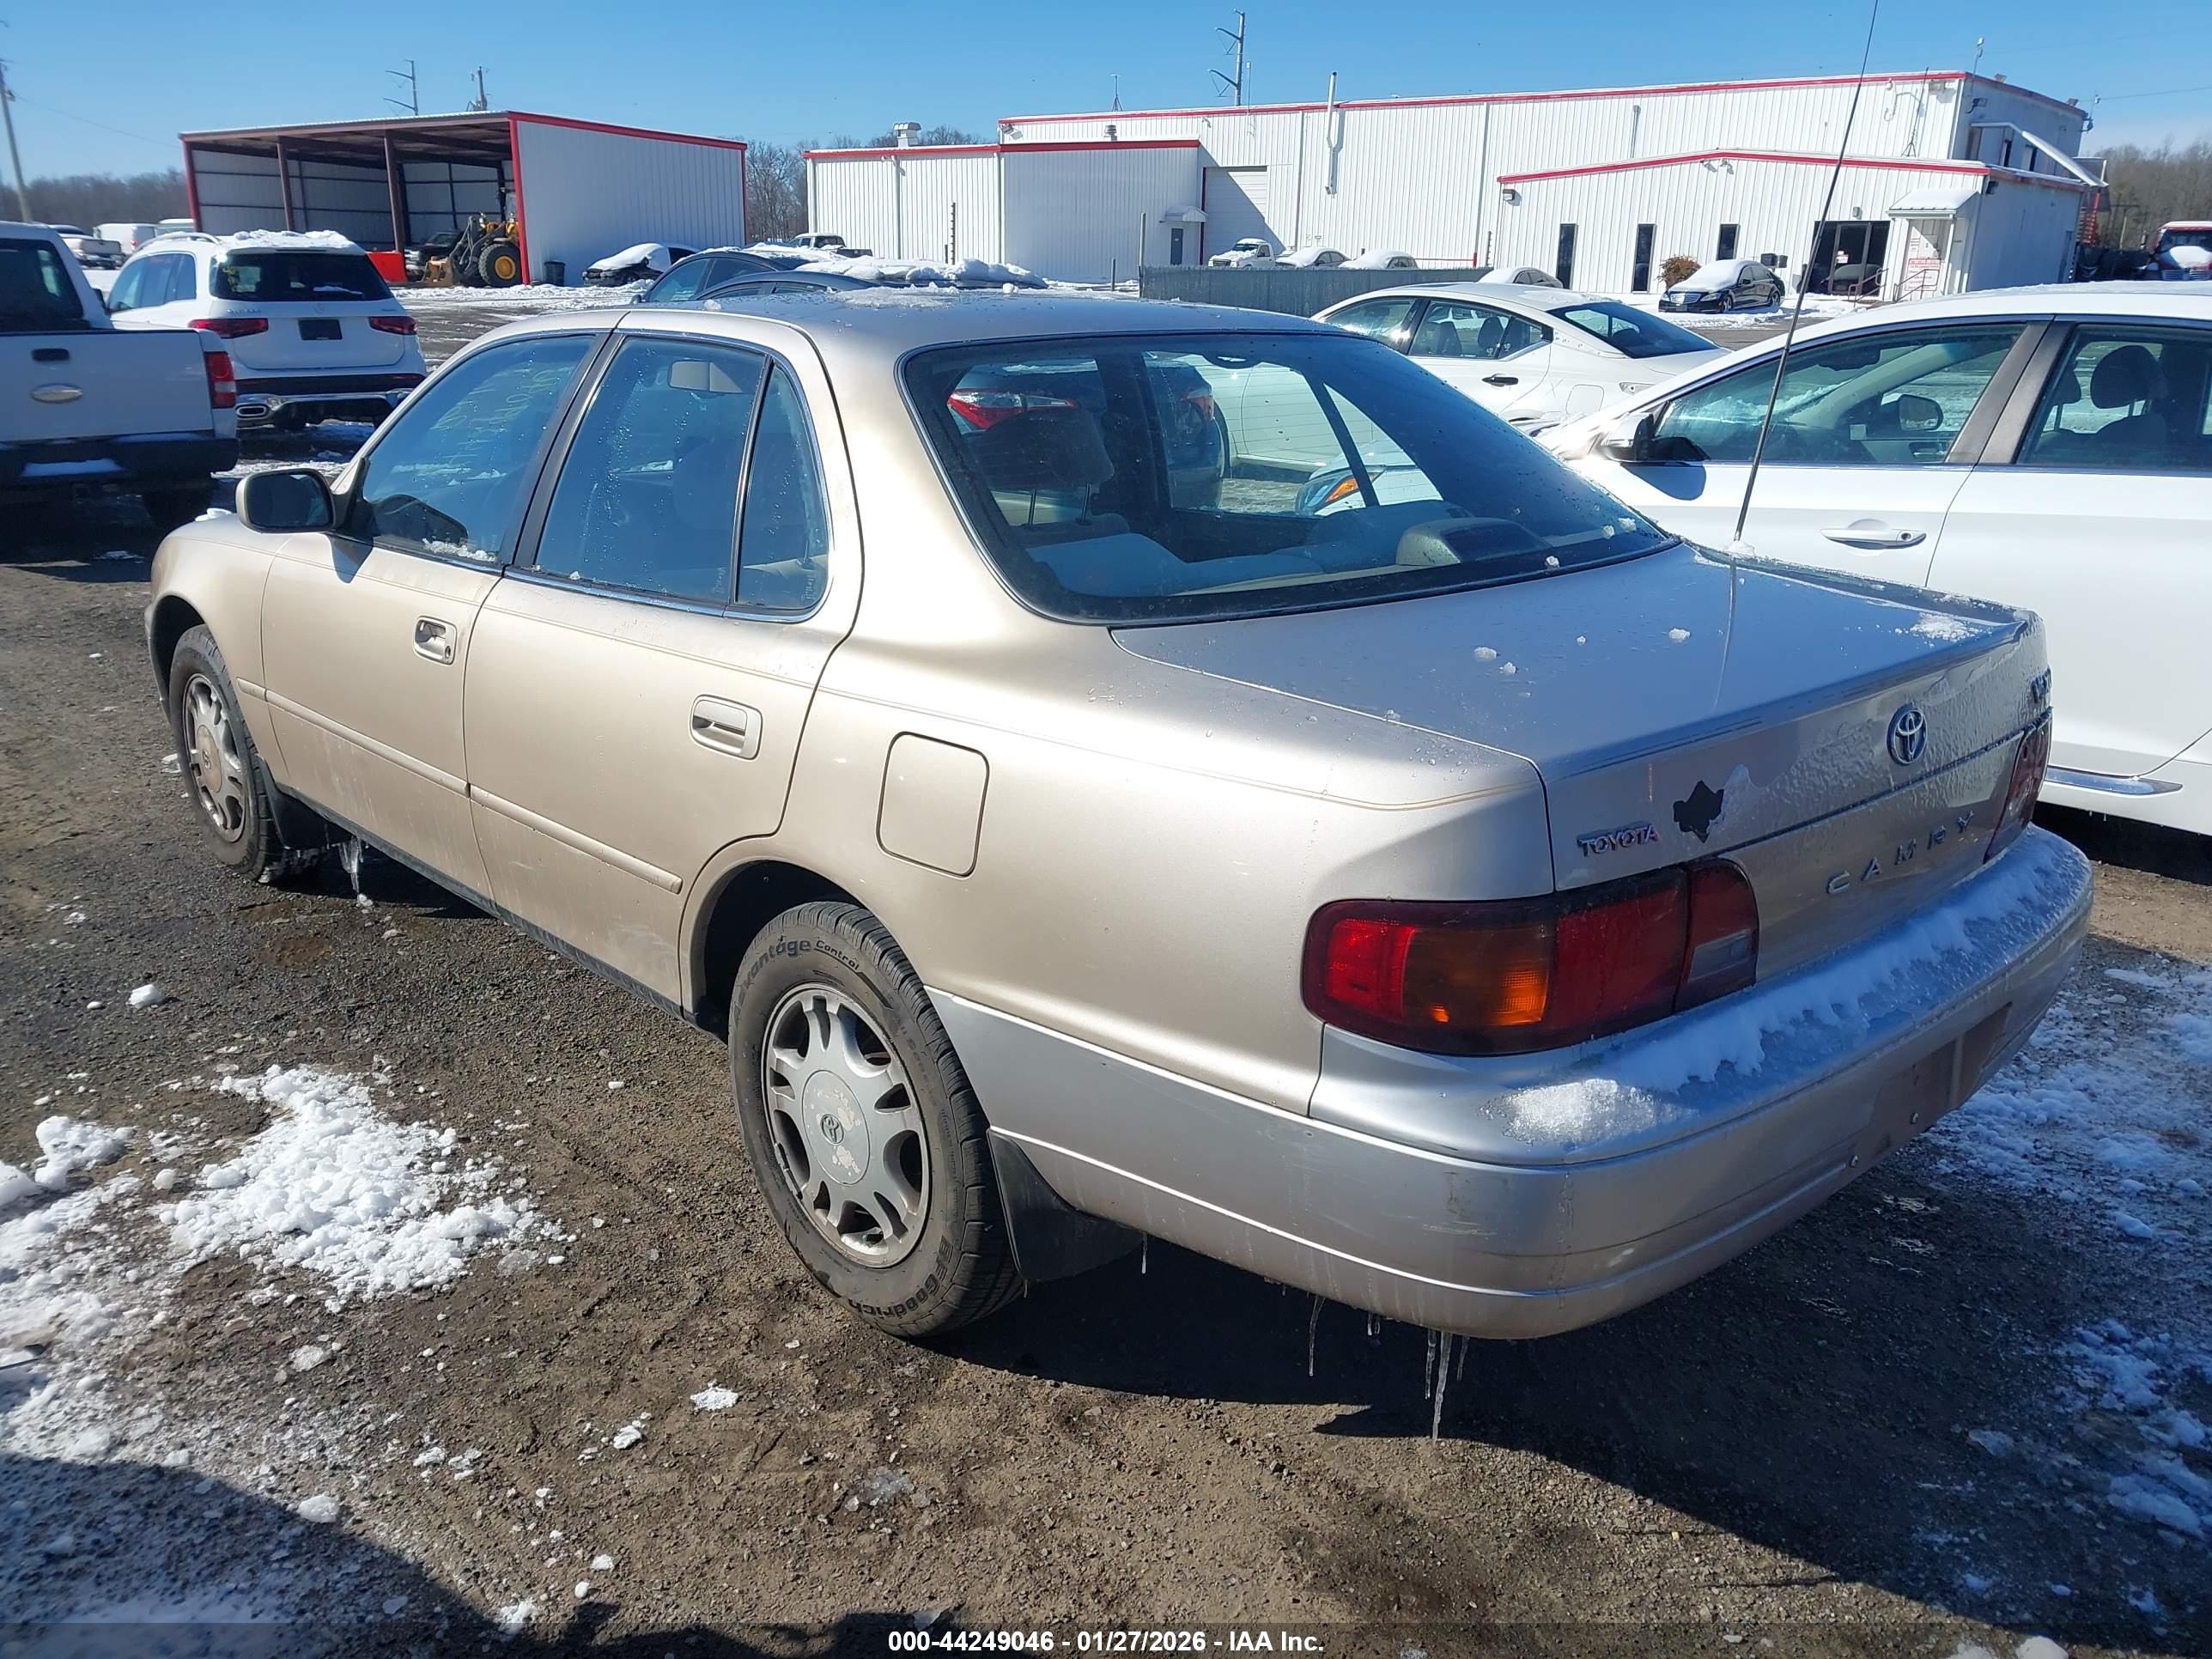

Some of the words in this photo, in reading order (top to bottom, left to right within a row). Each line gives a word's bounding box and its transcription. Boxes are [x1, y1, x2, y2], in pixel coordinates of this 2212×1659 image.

[1578, 823, 1659, 857] TOYOTA
[1826, 810, 1974, 895] CAMRY
[816, 939, 860, 971] Control
[848, 1235, 953, 1320] BFGoodrich
